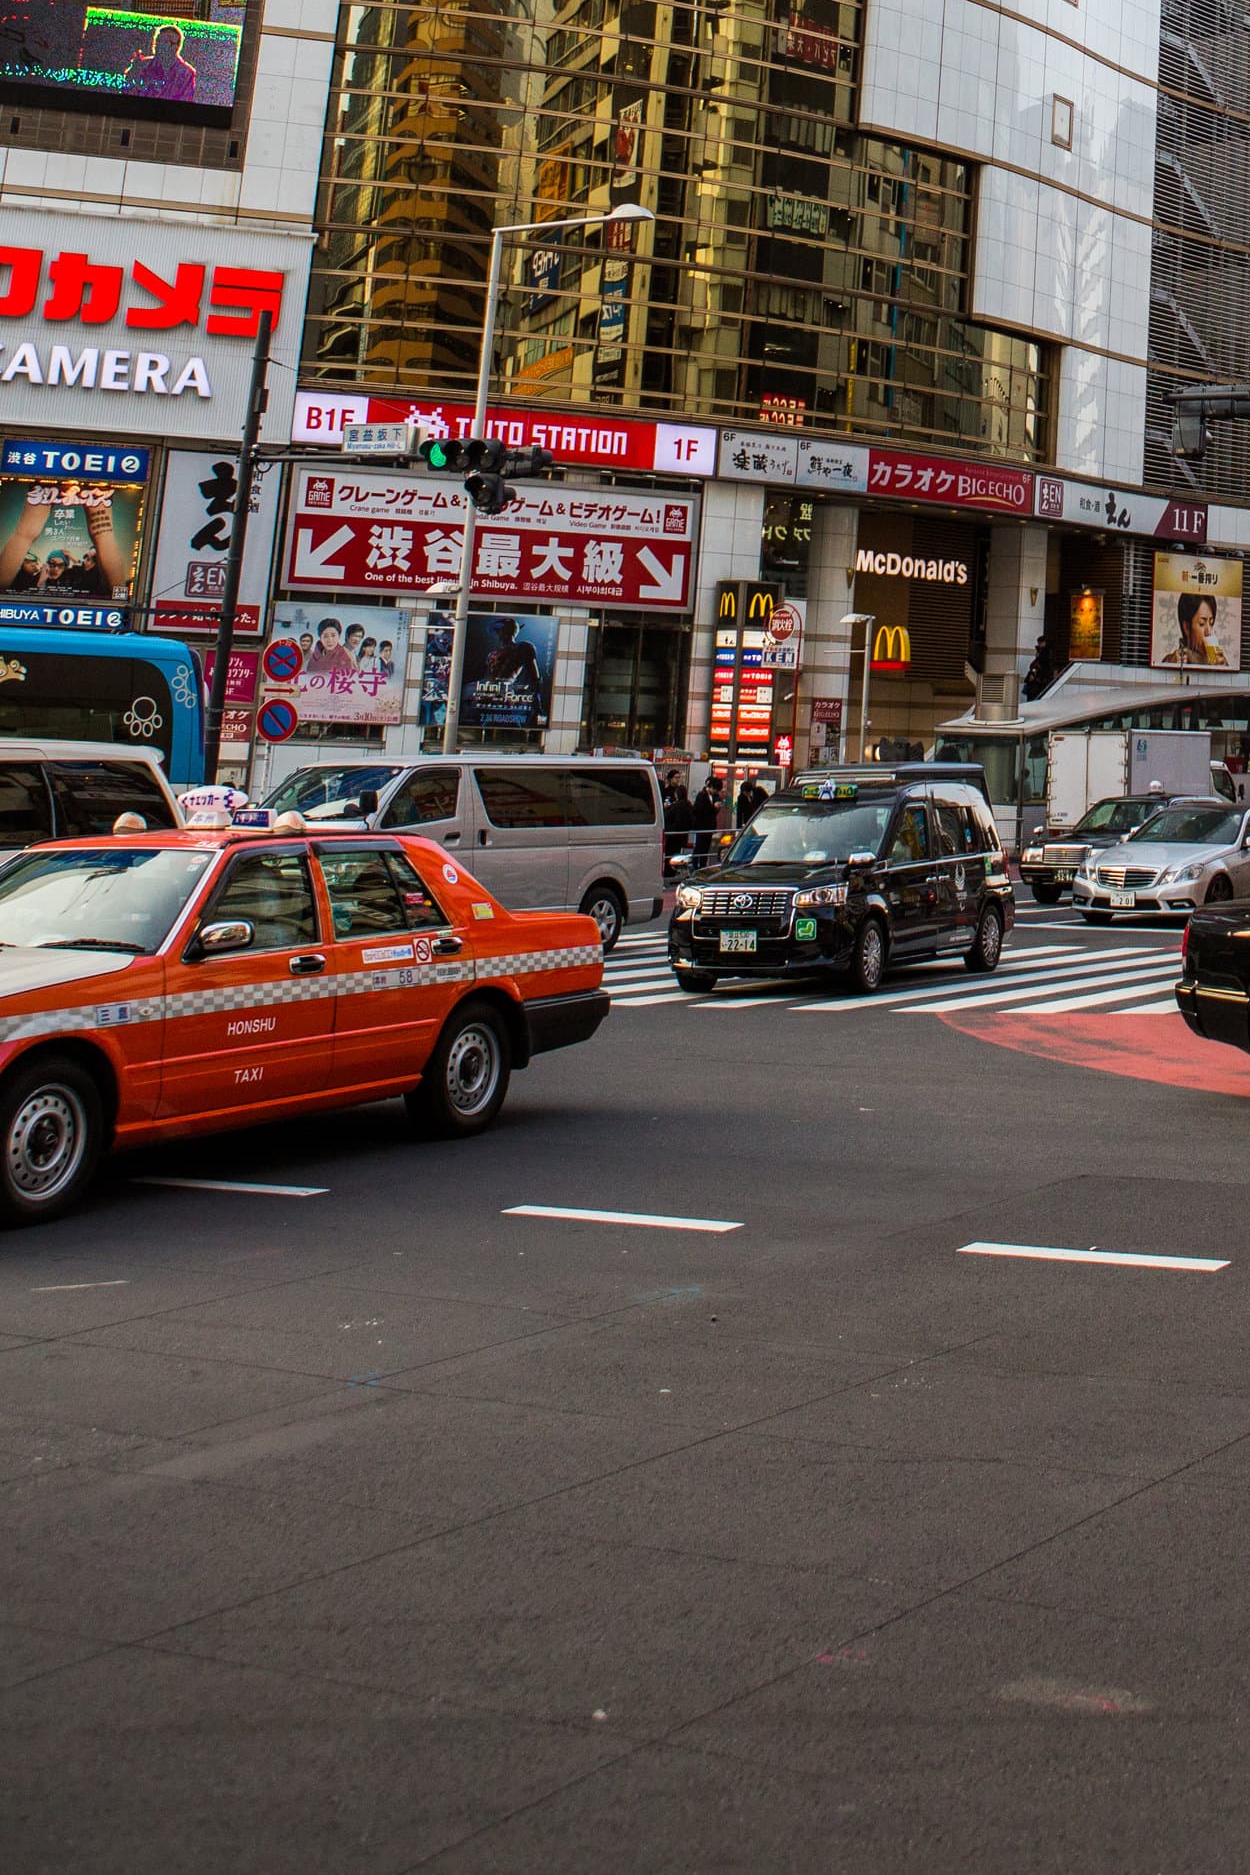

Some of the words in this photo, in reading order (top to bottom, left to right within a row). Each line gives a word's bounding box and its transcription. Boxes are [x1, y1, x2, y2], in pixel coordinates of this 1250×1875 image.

[0, 342, 212, 398] AMERA
[456, 416, 524, 447] TITO
[531, 423, 628, 456] STATION
[673, 438, 699, 461] 1F
[42, 450, 116, 473] TOEI
[870, 461, 956, 494] カラオケ
[337, 485, 448, 509] クレーンゲーム
[365, 523, 624, 584] 渋谷最大級
[856, 548, 968, 585] McDonald's
[398, 970, 414, 984] 58
[227, 1017, 276, 1036] HONSHU
[233, 1067, 264, 1084] TAXI
